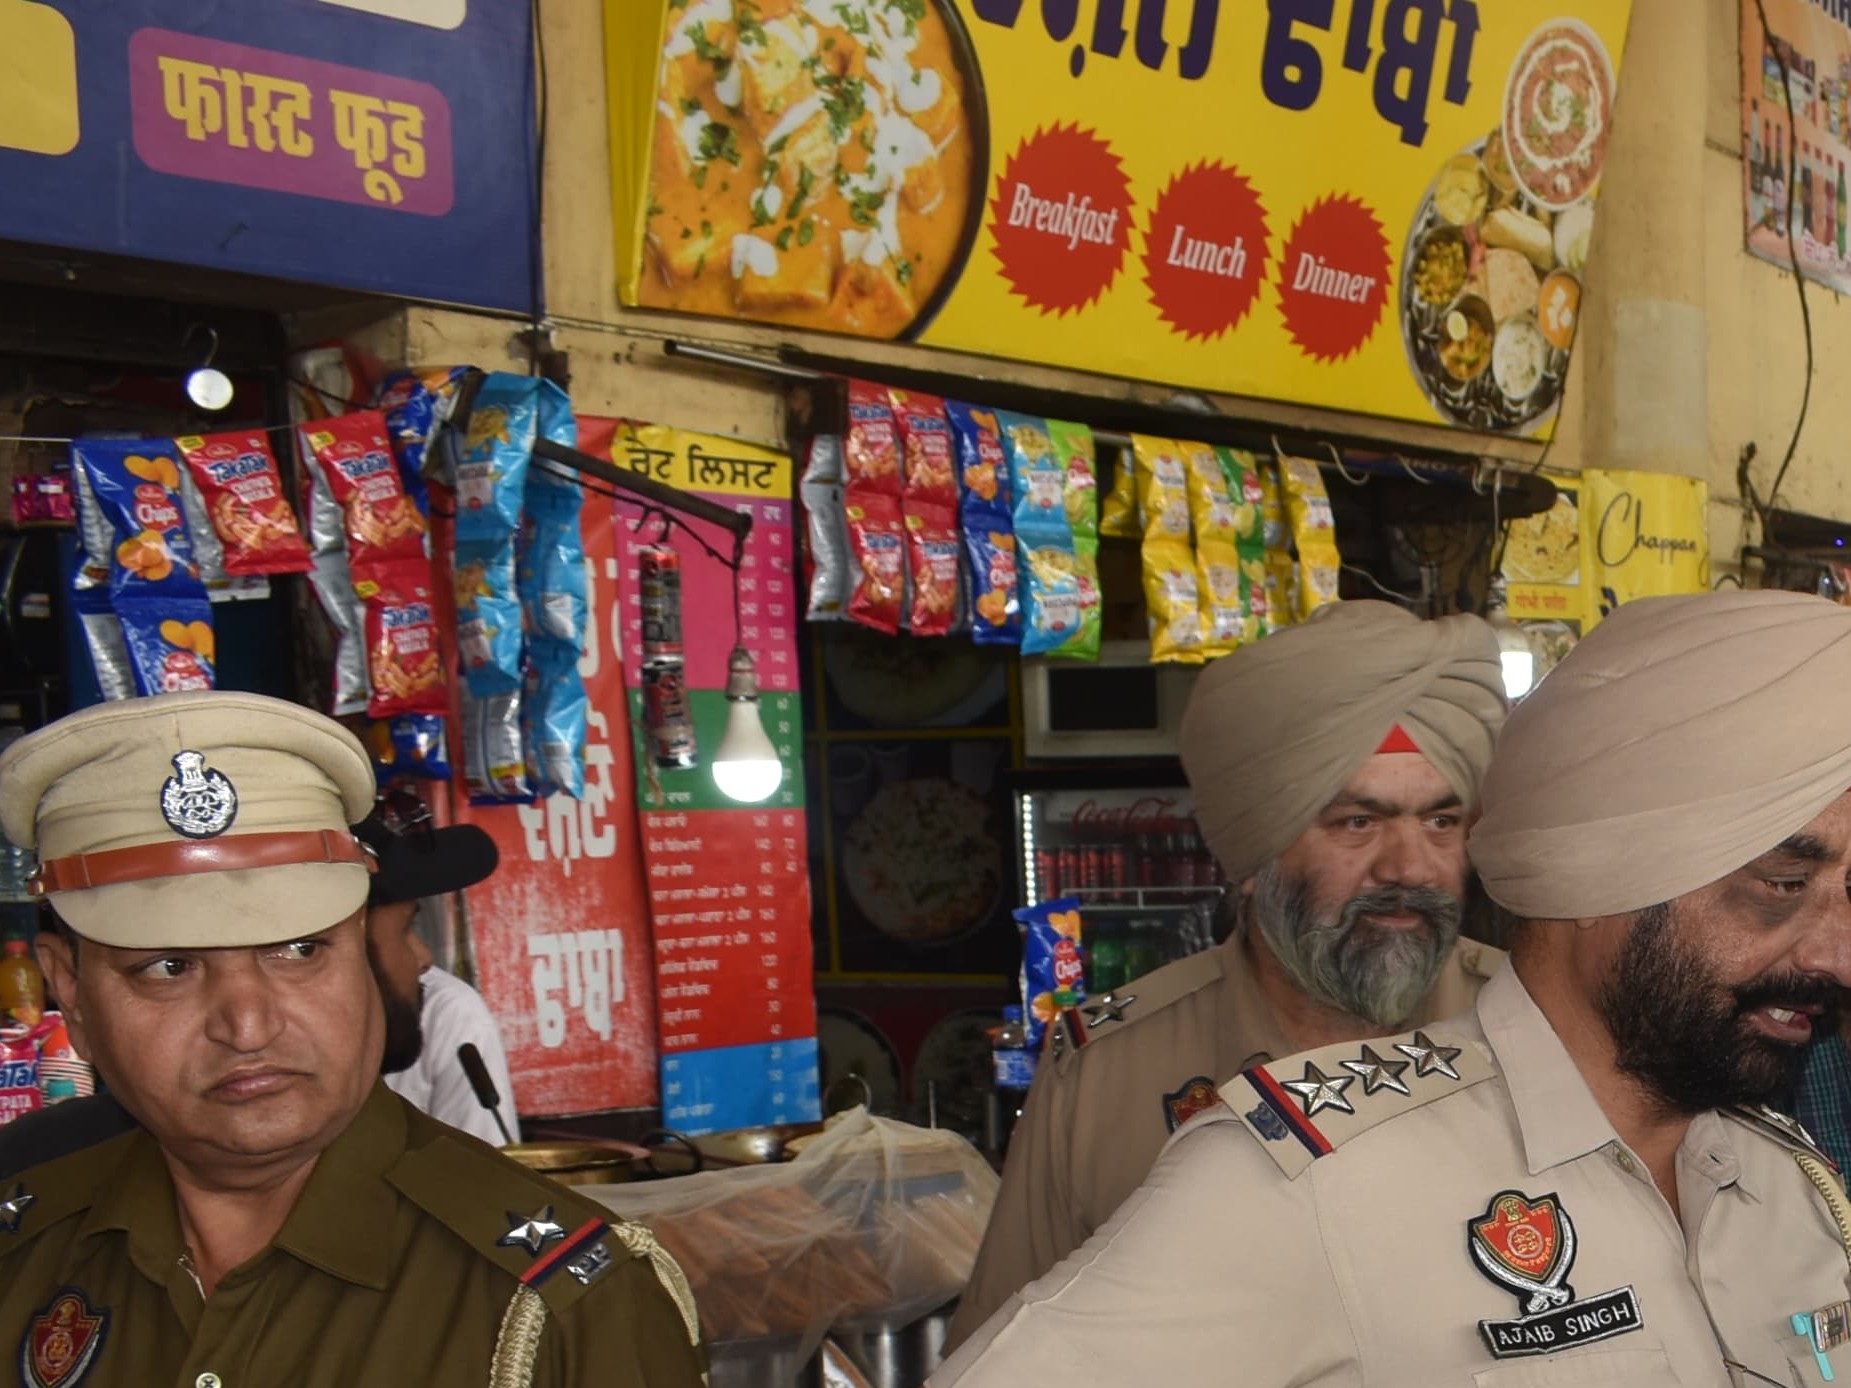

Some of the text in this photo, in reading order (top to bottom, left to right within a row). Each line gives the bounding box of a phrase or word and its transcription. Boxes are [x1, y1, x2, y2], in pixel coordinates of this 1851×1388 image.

[158, 56, 426, 204] फास्ट फूड
[1008, 182, 1118, 251] Breakfast
[1167, 224, 1247, 279] Lunch
[1292, 252, 1376, 304] Dinner
[206, 453, 272, 484] TakaTak
[337, 451, 391, 478] TakaTak
[688, 444, 778, 488] ਲਿਸਟ
[138, 503, 178, 524] Chips
[1597, 492, 1696, 567] Chappan
[526, 927, 624, 1048] ਢਾਬਾ
[1499, 1302, 1631, 1346] AJAIB SINGH
